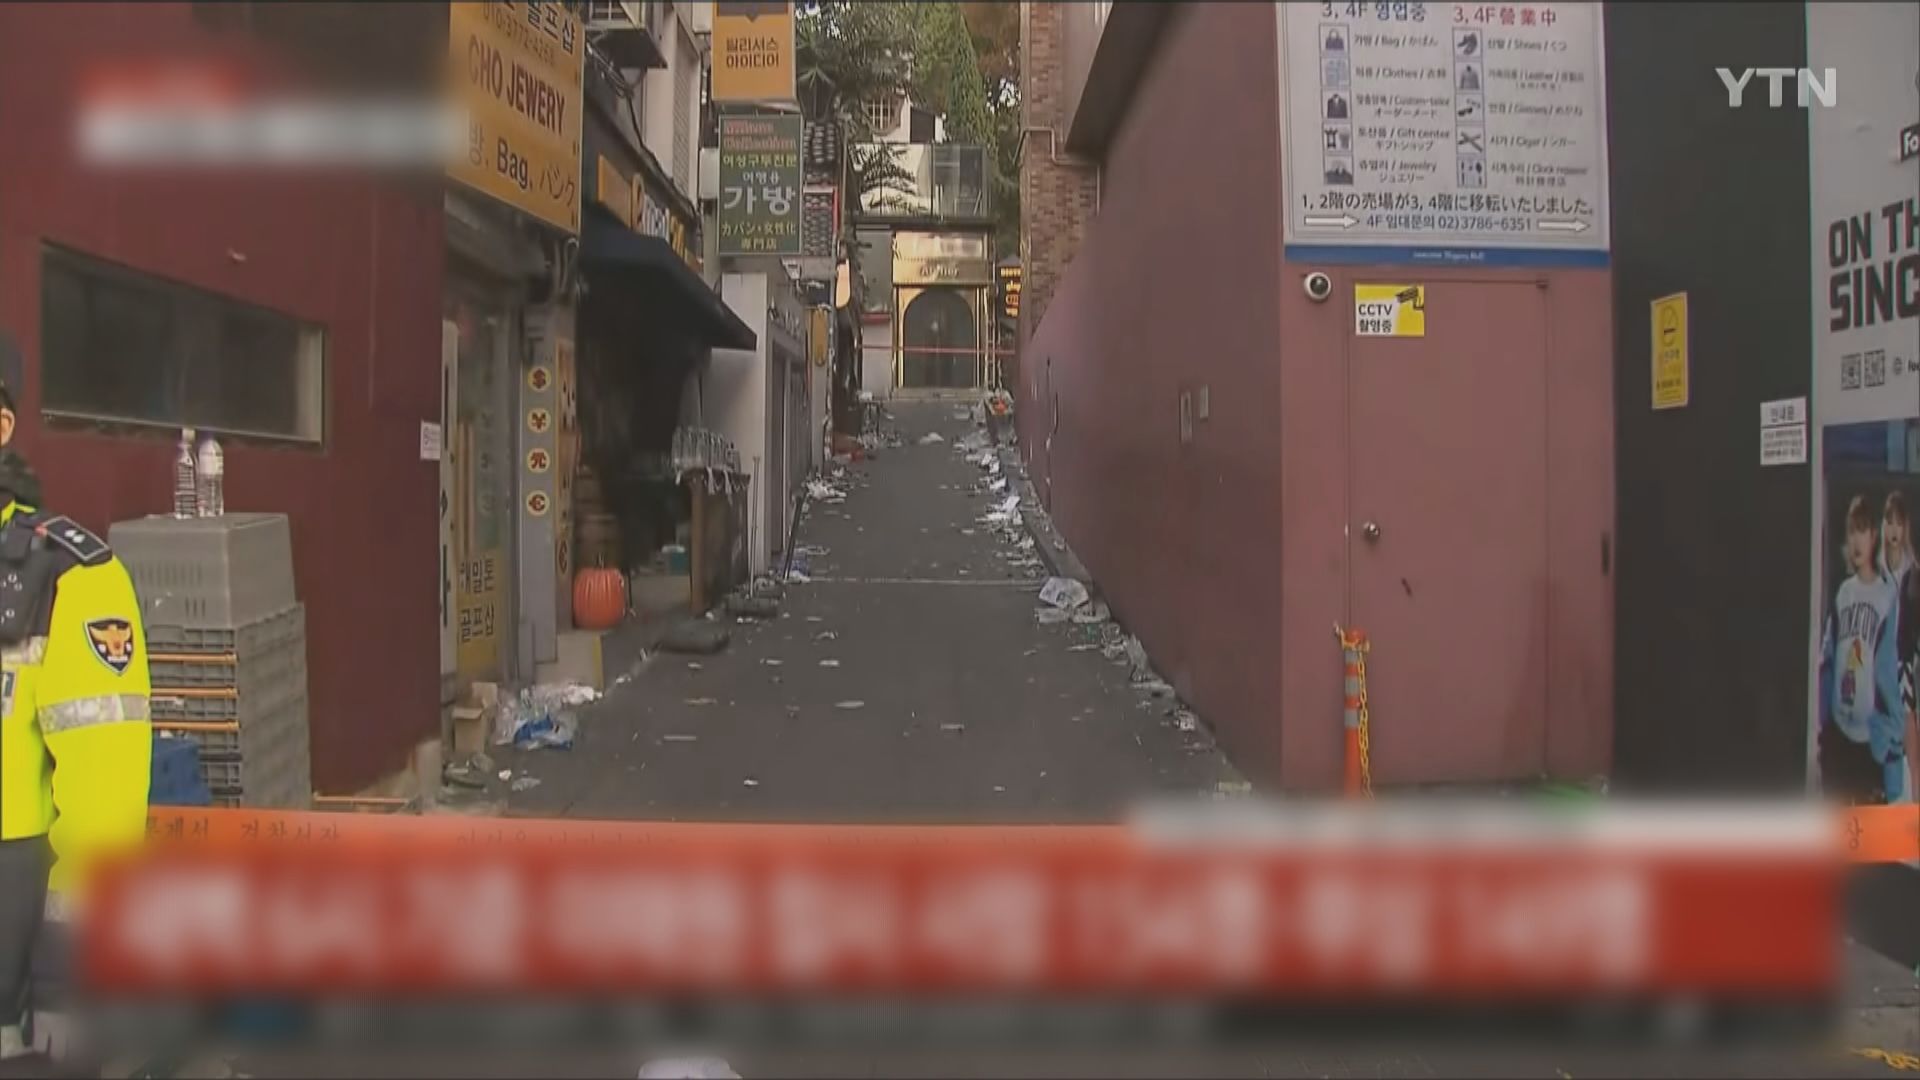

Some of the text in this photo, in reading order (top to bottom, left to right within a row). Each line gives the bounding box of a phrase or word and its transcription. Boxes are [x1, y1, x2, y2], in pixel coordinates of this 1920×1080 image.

[468, 32, 503, 100] CHO
[507, 60, 566, 137] JEWERY
[723, 186, 797, 216] 가방
[1828, 212, 1873, 269] ON
[1358, 303, 1393, 316] CCTV
